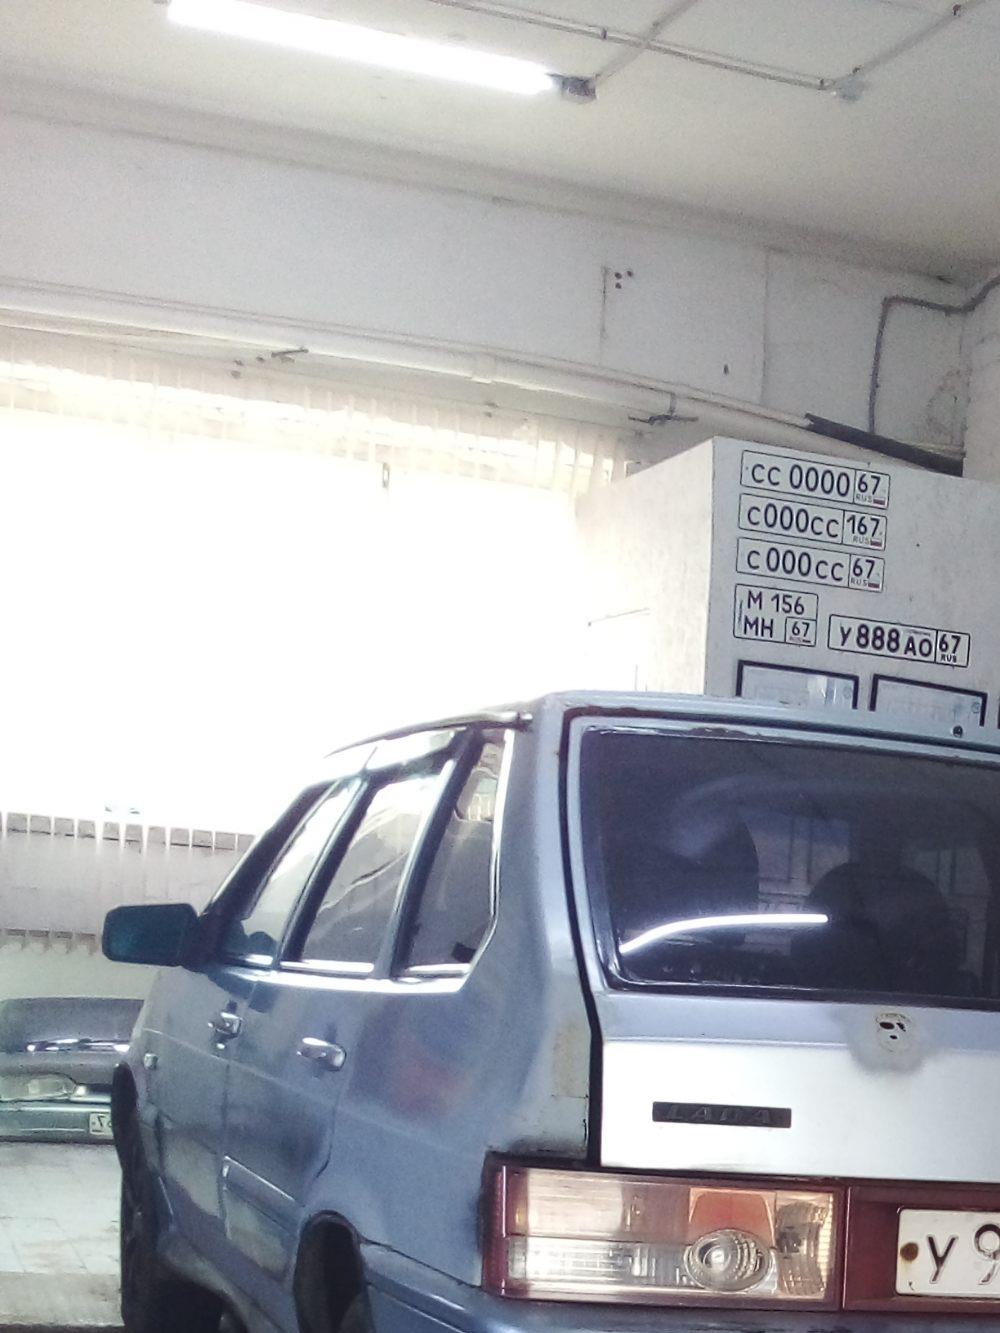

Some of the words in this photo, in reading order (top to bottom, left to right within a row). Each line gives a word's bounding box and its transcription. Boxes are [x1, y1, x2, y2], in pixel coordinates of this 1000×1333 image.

[858, 474, 881, 495] 67
[847, 514, 880, 537] 167
[852, 558, 876, 579] 67
[792, 621, 810, 637] 67
[939, 634, 961, 654] 67
